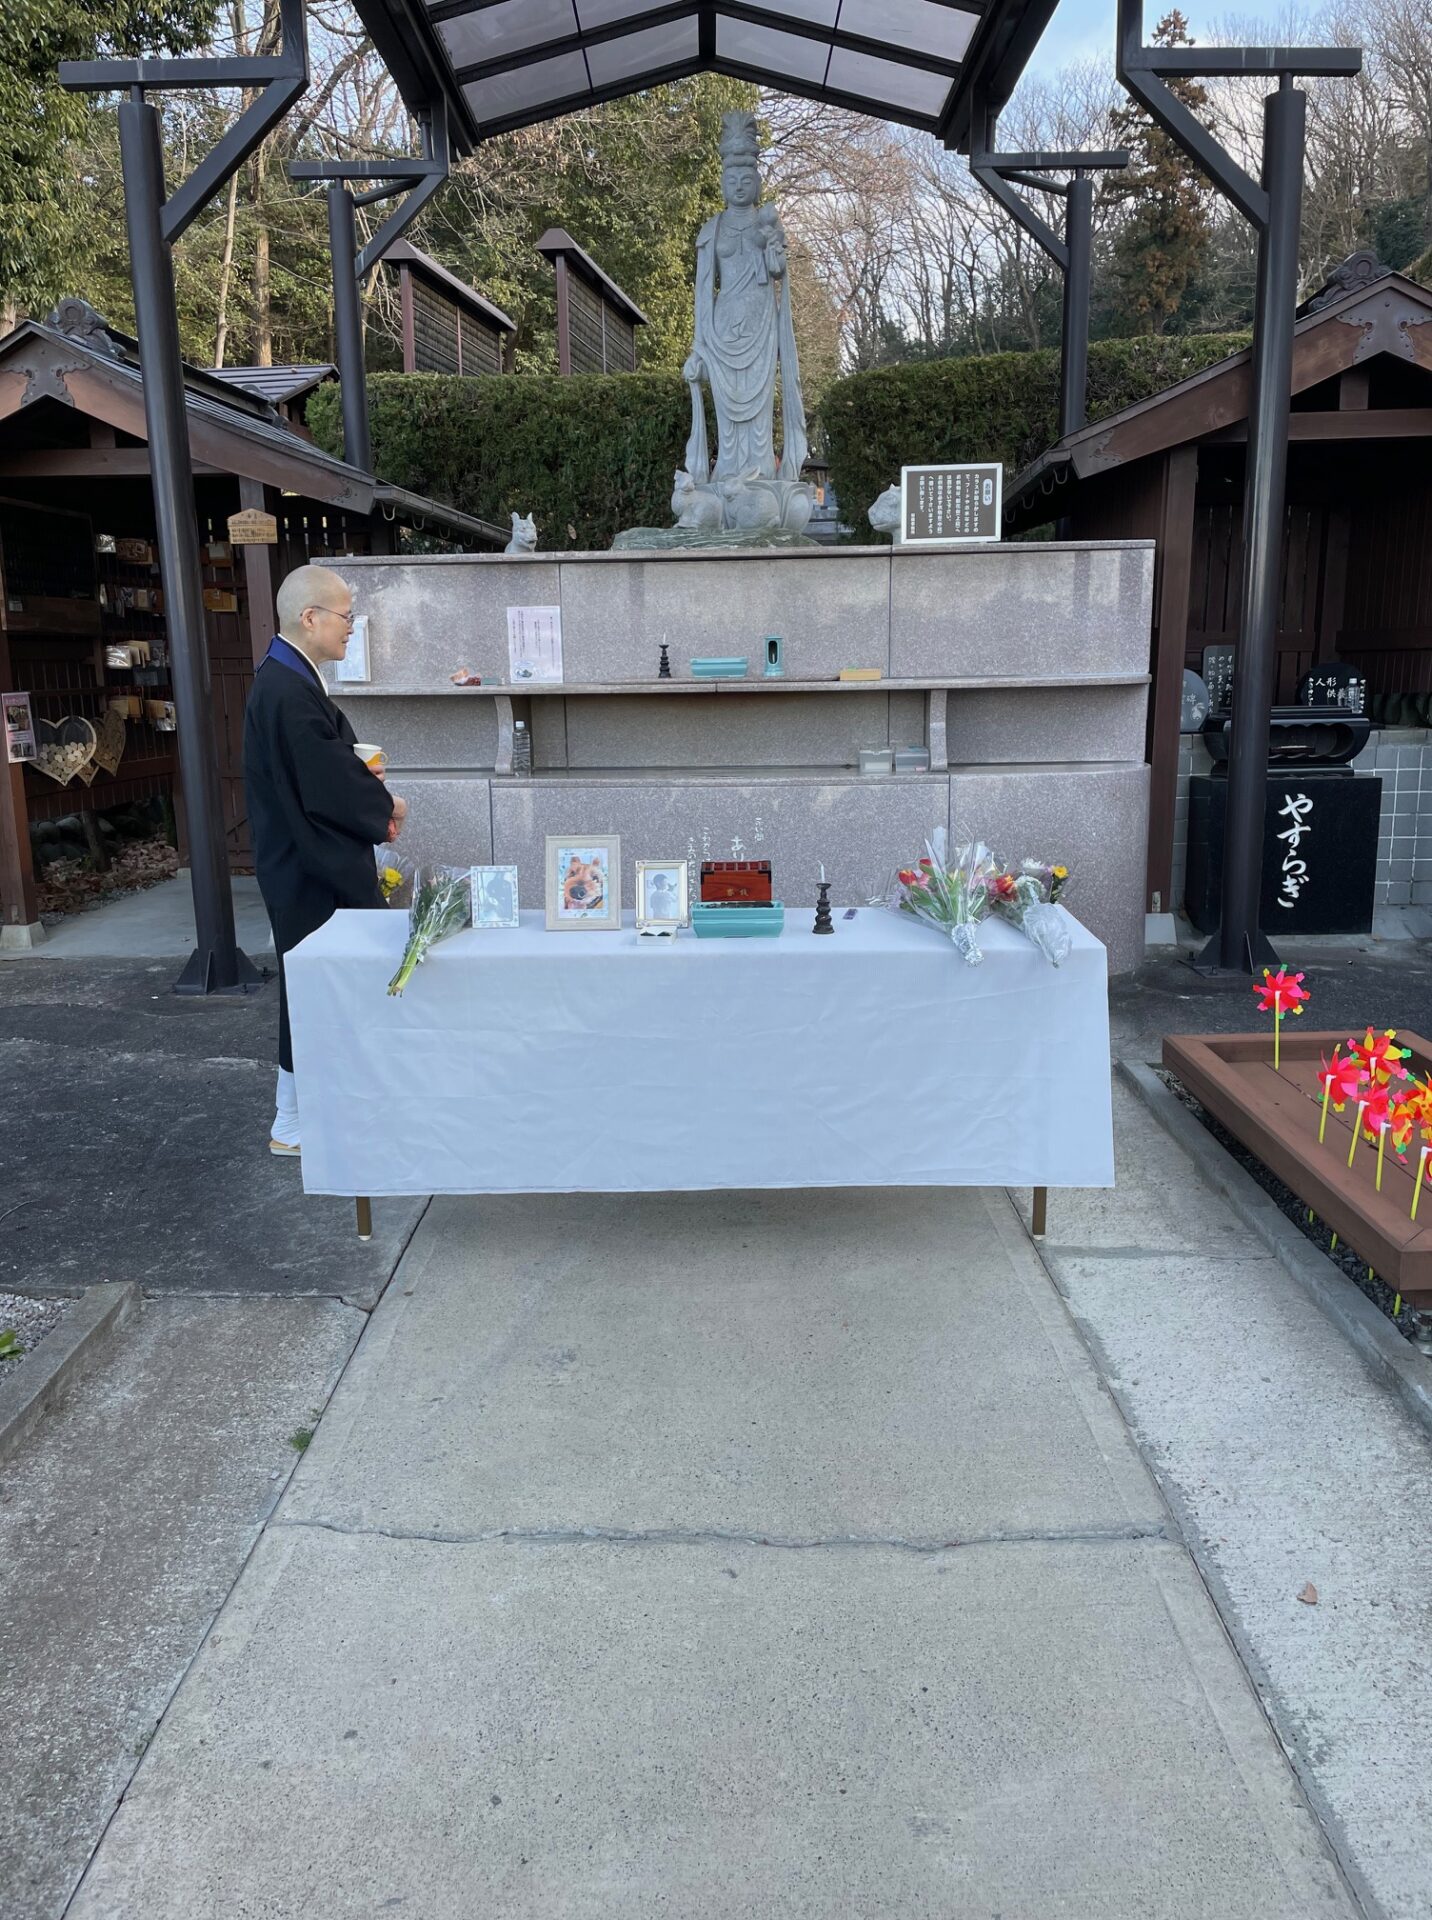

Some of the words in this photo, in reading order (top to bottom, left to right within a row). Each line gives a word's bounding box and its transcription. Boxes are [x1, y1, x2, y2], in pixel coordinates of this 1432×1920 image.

[1315, 677, 1337, 687] 人形
[1276, 793, 1314, 909] やすらぎ
